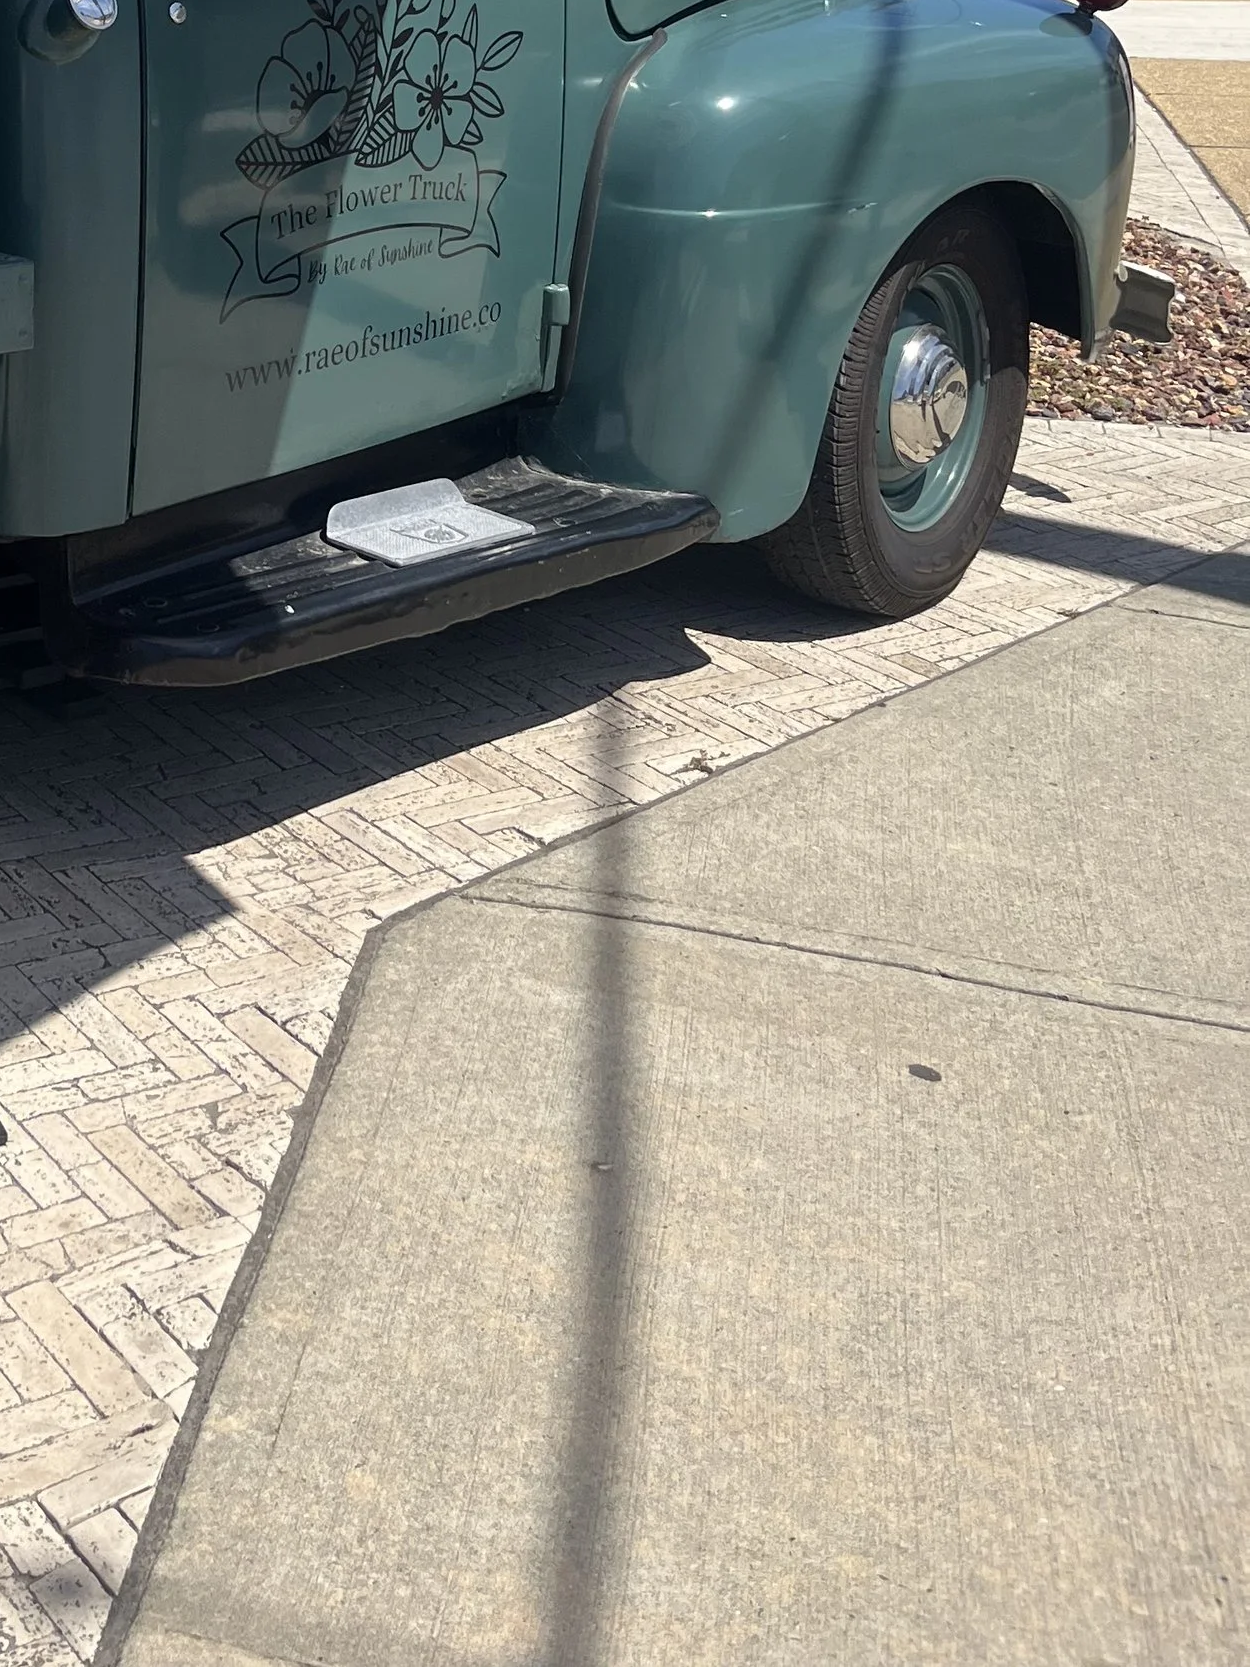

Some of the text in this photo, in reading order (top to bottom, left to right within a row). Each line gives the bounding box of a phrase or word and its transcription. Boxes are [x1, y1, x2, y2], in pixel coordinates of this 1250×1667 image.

[270, 173, 467, 240] The Flower Truck
[307, 238, 433, 284] By Rae of Sunshine
[225, 301, 502, 392] www.raeofsunshine.co
